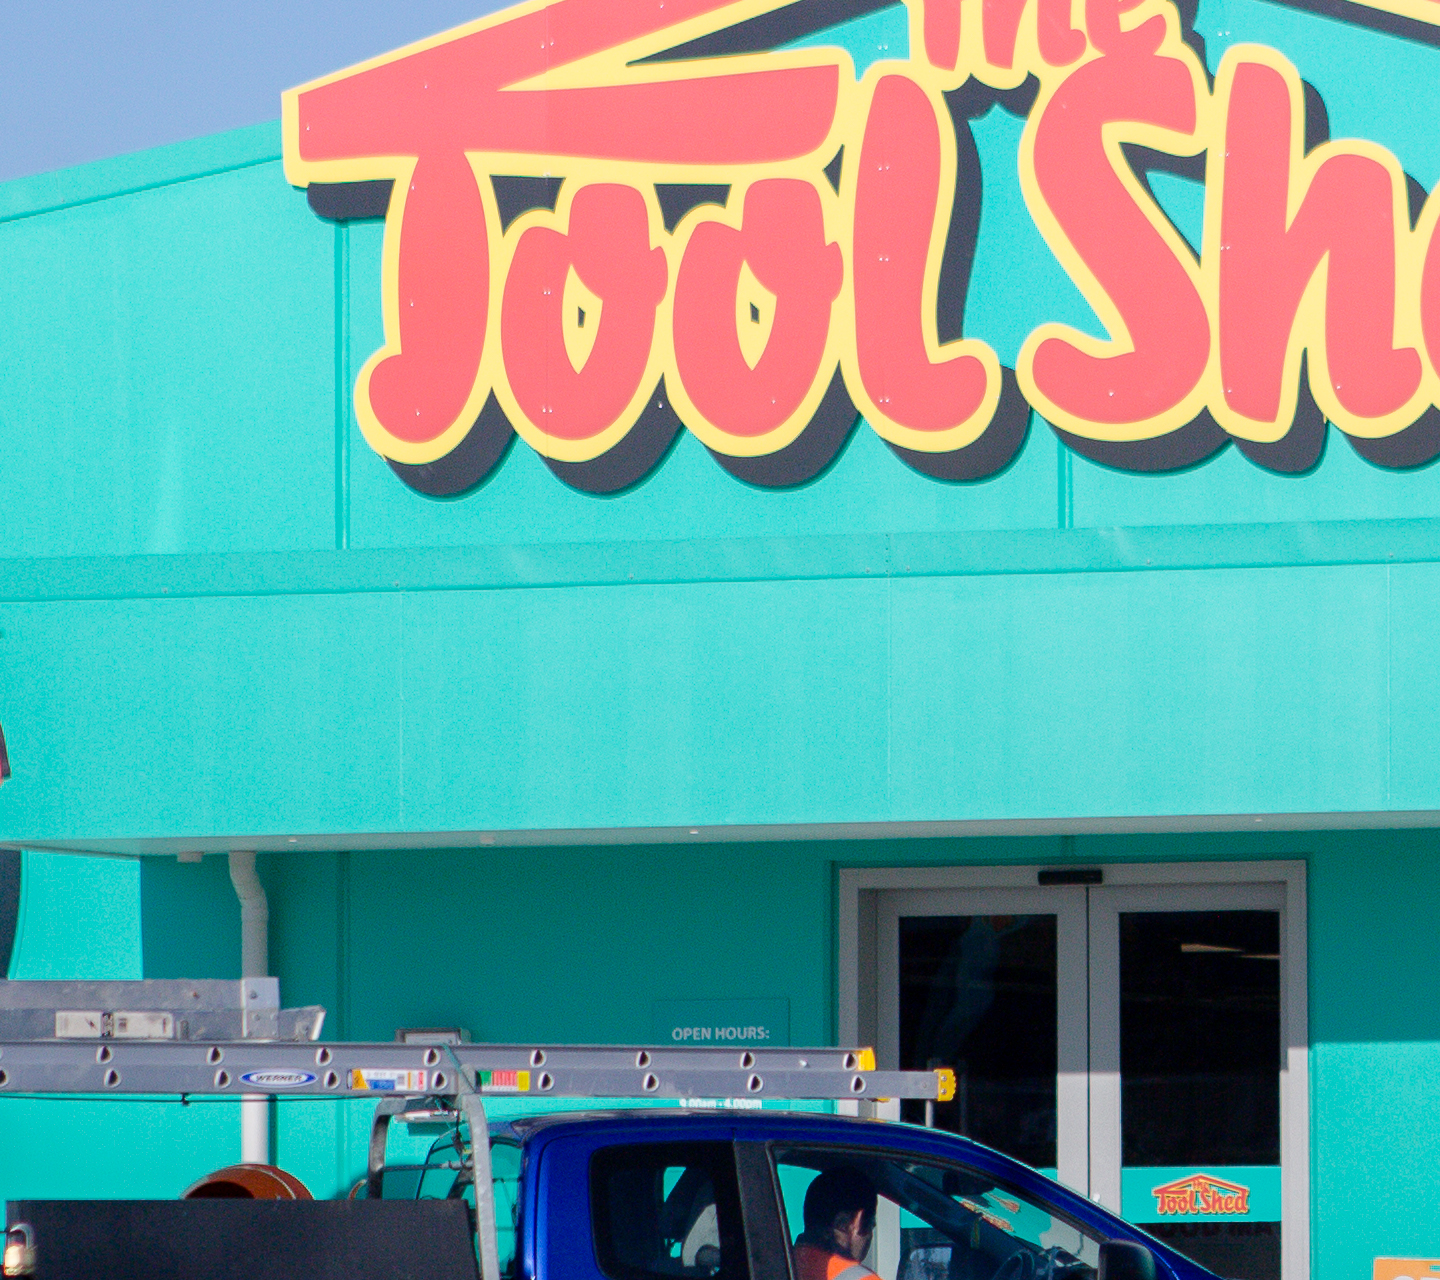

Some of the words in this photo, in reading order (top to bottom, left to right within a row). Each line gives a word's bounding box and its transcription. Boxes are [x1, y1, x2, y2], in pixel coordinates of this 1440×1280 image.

[285, 60, 1001, 462] Tool
[671, 1026, 712, 1040] OPEN
[715, 1025, 770, 1040] HOURS:
[1153, 1188, 1198, 1214] Tool
[1200, 1187, 1249, 1214] Shed
